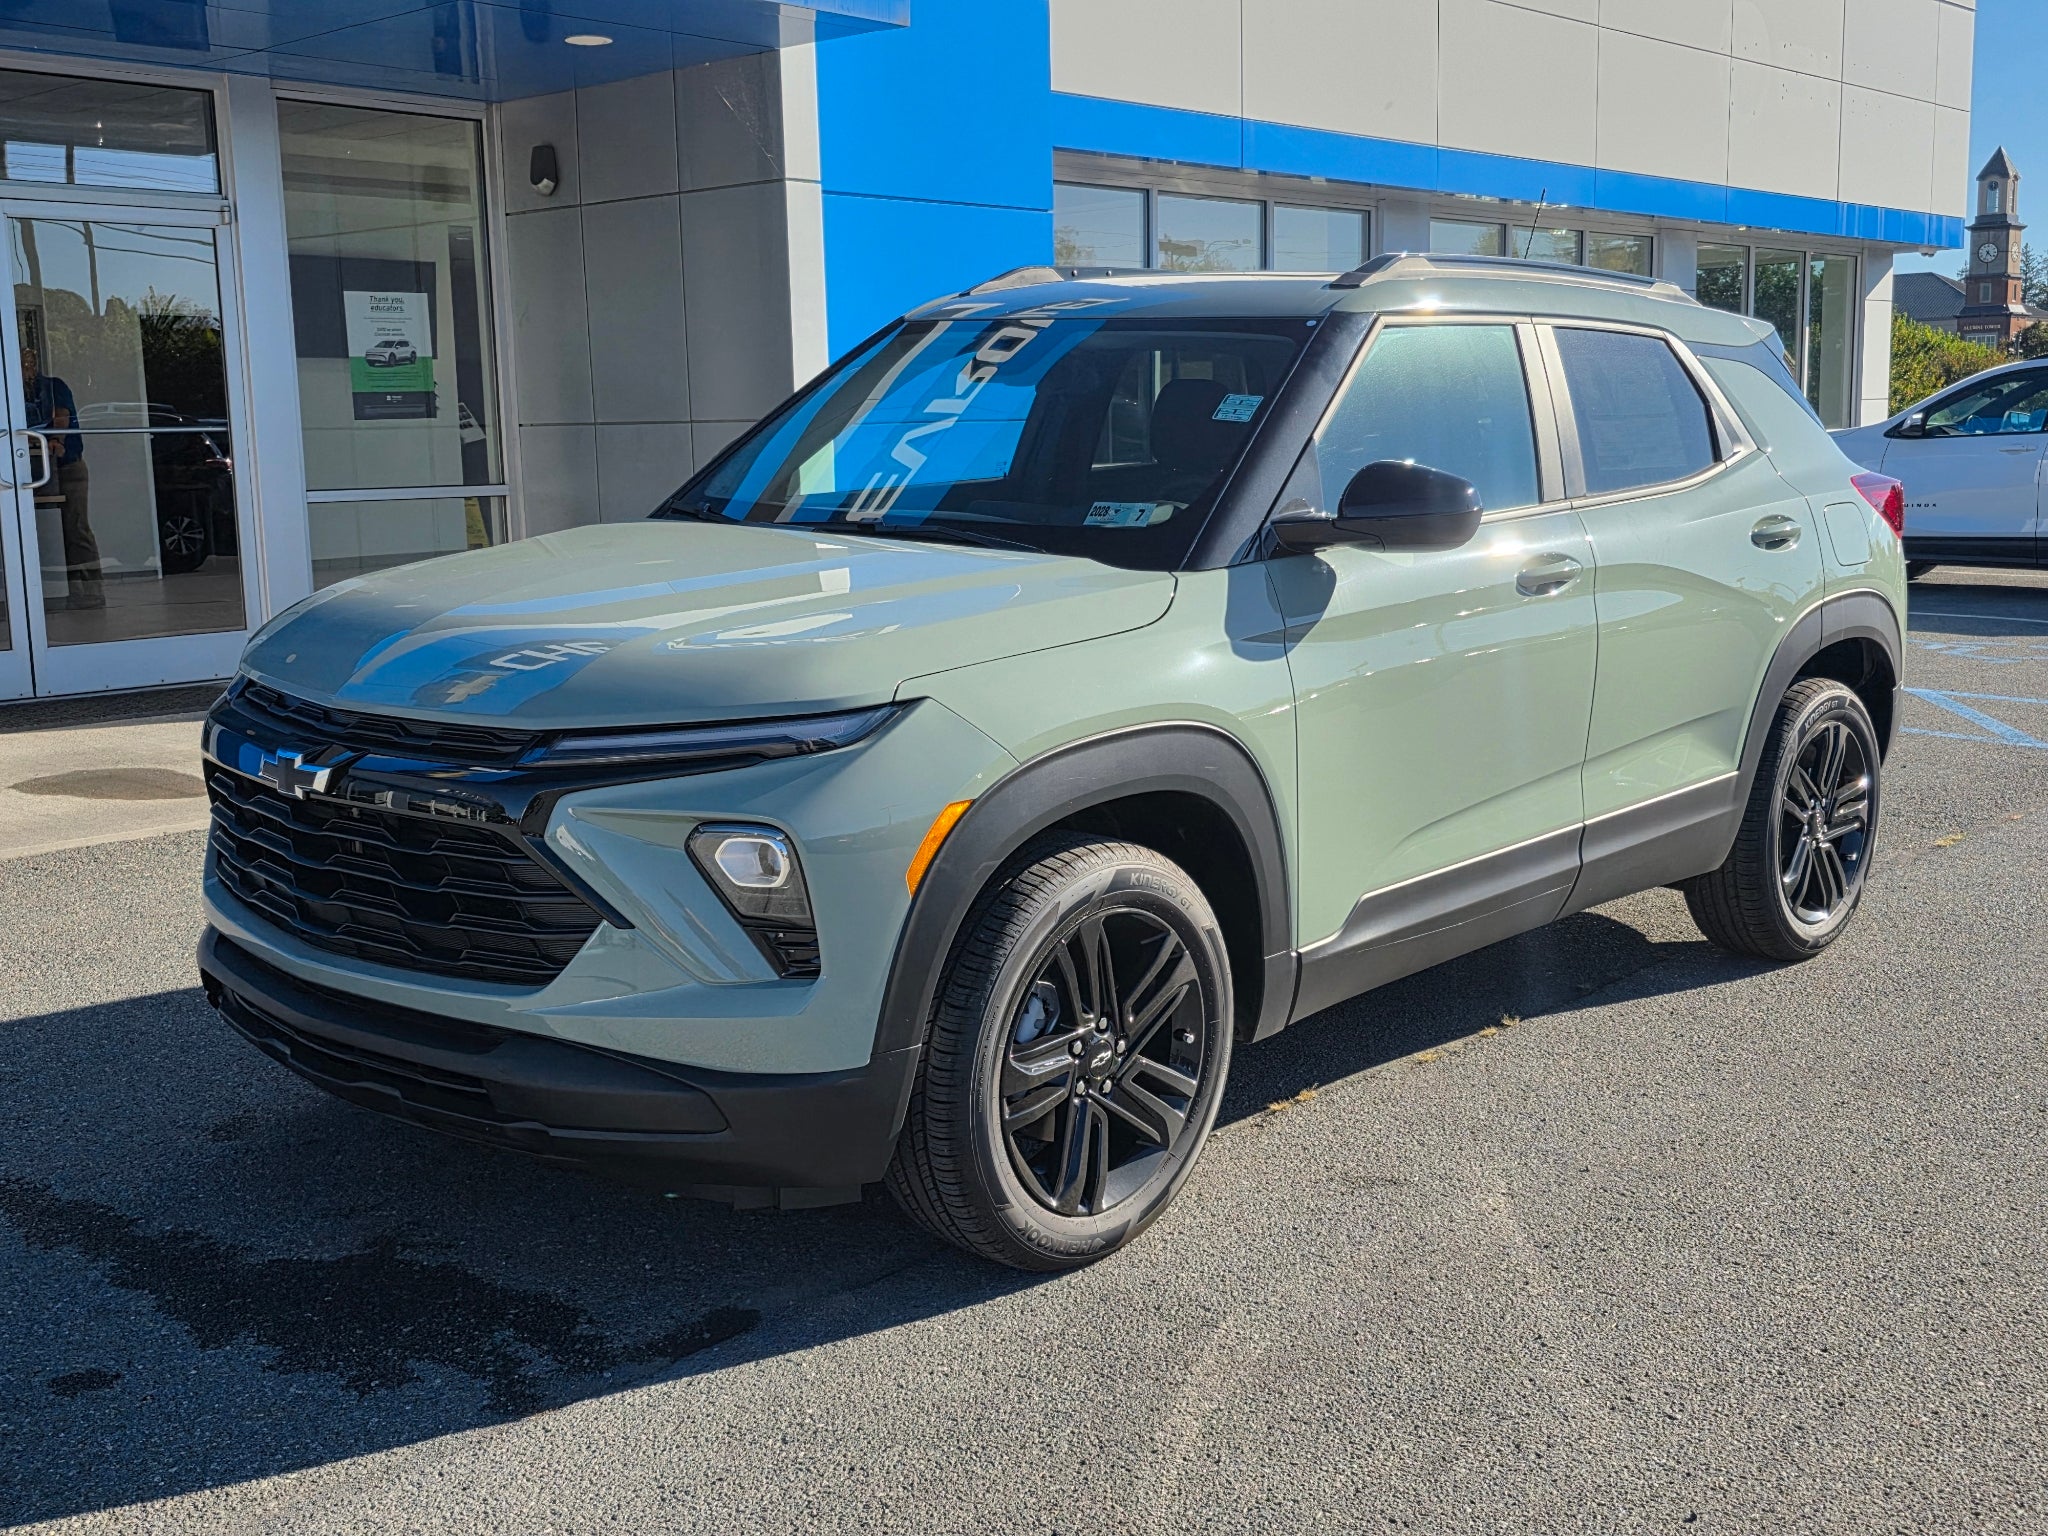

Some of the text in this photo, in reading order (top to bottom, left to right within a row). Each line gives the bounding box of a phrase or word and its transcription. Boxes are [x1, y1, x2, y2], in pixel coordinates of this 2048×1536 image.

[1135, 508, 1146, 522] 7
[1130, 872, 1194, 911] KINERGY GT
